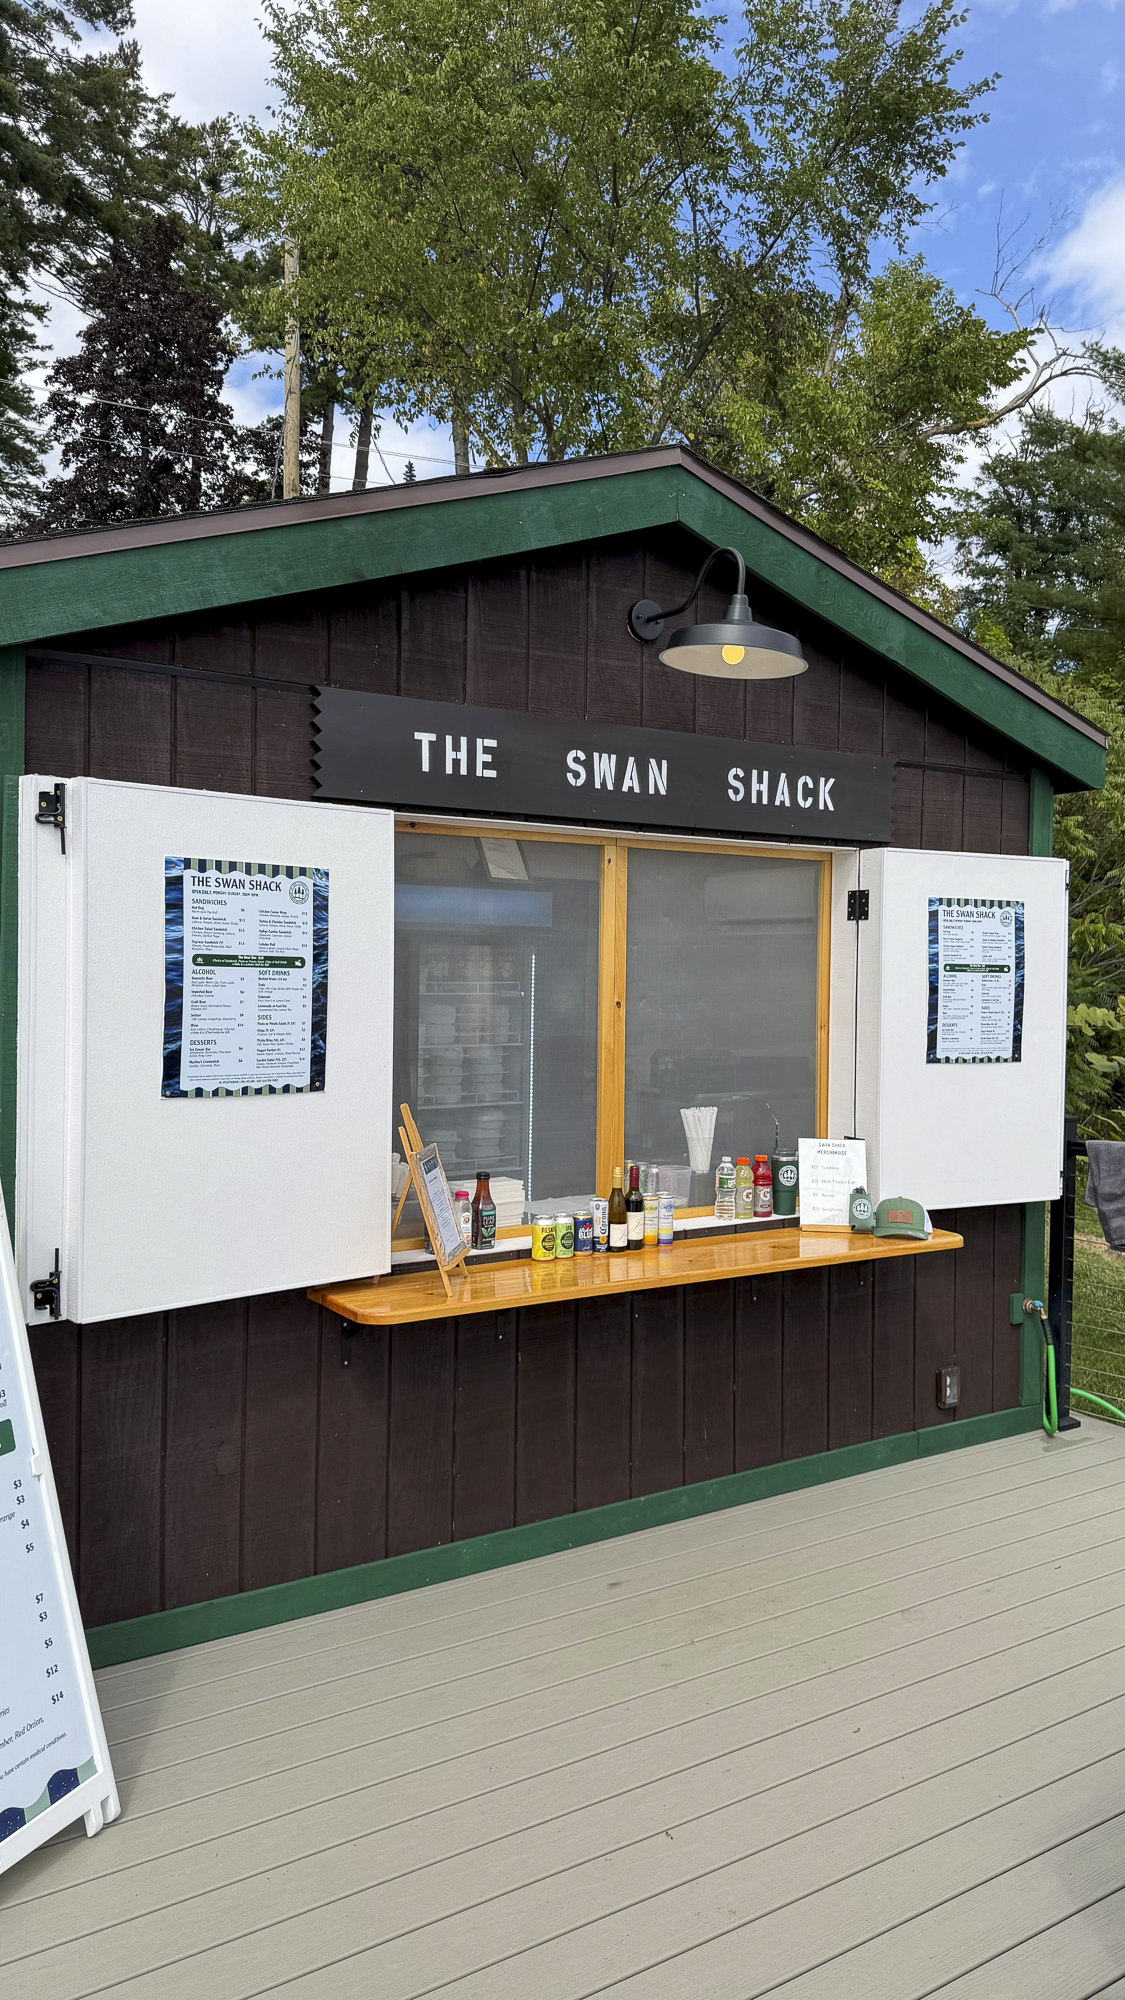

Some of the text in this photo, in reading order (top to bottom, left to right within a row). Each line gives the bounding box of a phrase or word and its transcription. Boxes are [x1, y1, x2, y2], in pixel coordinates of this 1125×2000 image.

[414, 732, 835, 811] THE SWAN SHACK
[191, 876, 282, 892] THE SWAN SHACK
[956, 910, 974, 918] SWAN
[976, 911, 996, 919] SHACK
[13, 1479, 22, 1490] $3
[16, 1495, 25, 1505] $3
[21, 1519, 30, 1529] $4
[26, 1542, 34, 1553] $5
[36, 1593, 43, 1604] $7
[39, 1611, 48, 1622] $3
[44, 1637, 53, 1649] $5
[46, 1664, 58, 1678] $12
[51, 1690, 64, 1705] $14
[15, 1726, 26, 1740] Red
[26, 1717, 44, 1732] Onion,
[15, 1757, 30, 1770] certain
[30, 1744, 46, 1760] medical
[46, 1732, 67, 1748] conditions.
